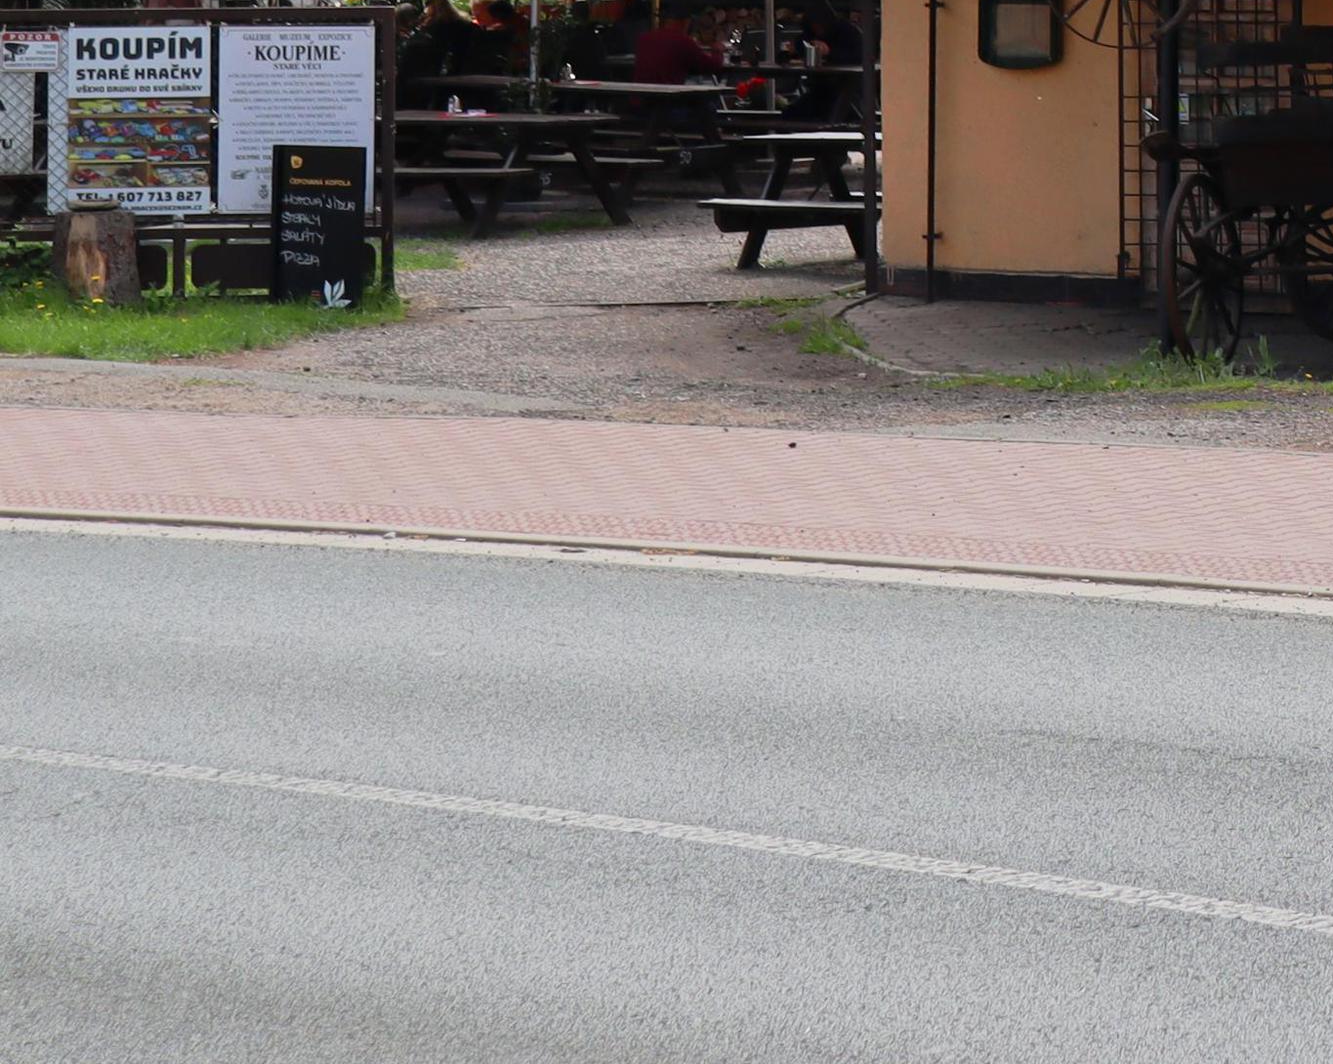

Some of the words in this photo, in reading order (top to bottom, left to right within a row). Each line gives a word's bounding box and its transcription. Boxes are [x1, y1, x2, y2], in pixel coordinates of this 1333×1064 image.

[76, 31, 203, 60] KOUPÍM
[254, 41, 341, 61] KOUPÍME
[76, 65, 129, 80] STARÉ
[134, 64, 202, 80] HRAČKY
[117, 191, 144, 201] 607
[147, 192, 172, 202] 713
[176, 191, 202, 202] 827
